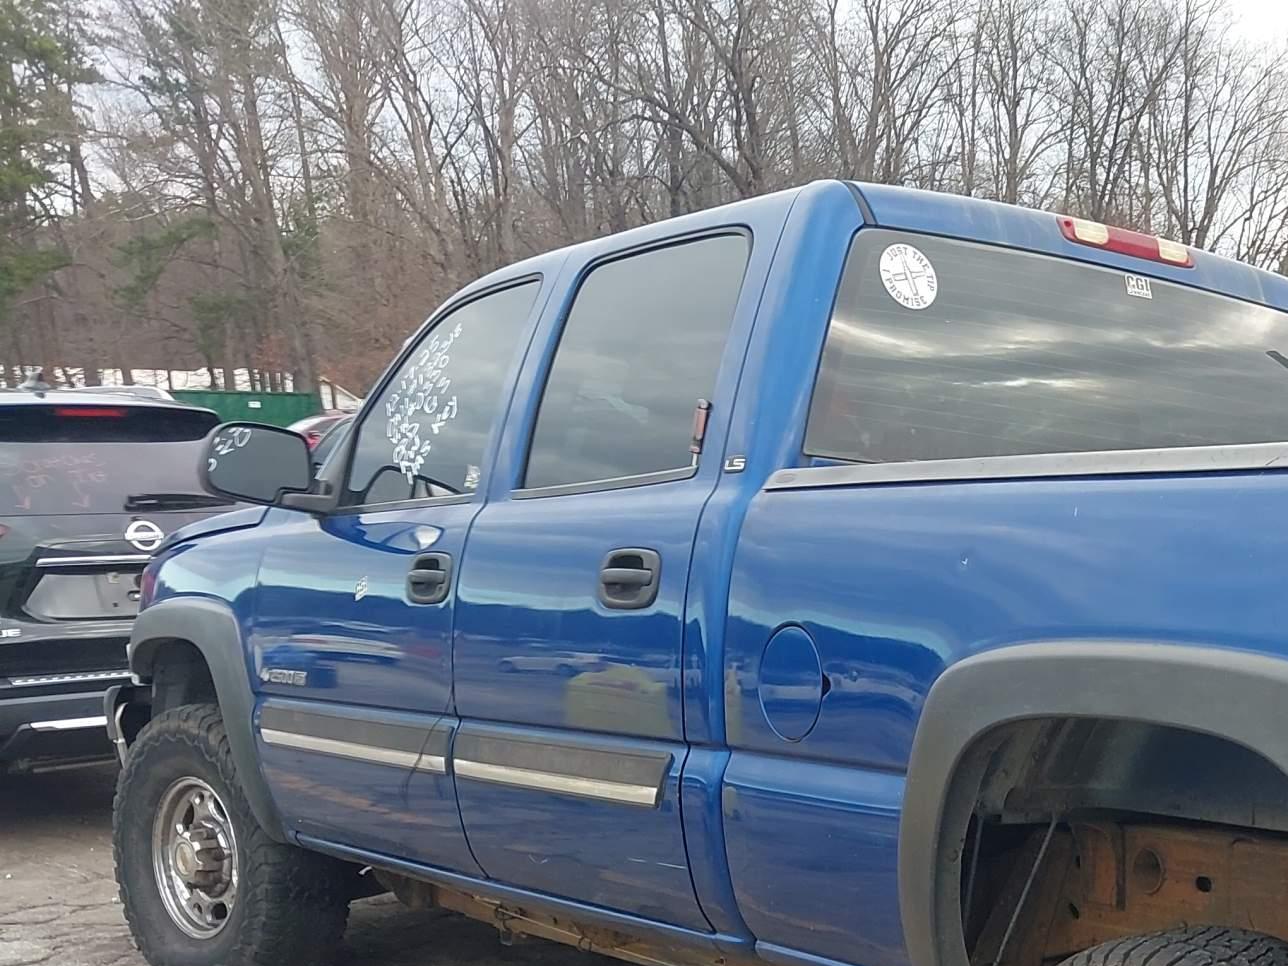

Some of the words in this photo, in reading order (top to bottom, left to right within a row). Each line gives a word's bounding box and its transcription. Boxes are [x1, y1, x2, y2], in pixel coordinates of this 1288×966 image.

[886, 246, 908, 261] JUST
[912, 251, 930, 271] THE
[926, 275, 935, 291] TIP
[886, 278, 927, 306] PROMISE
[723, 458, 746, 471] LS
